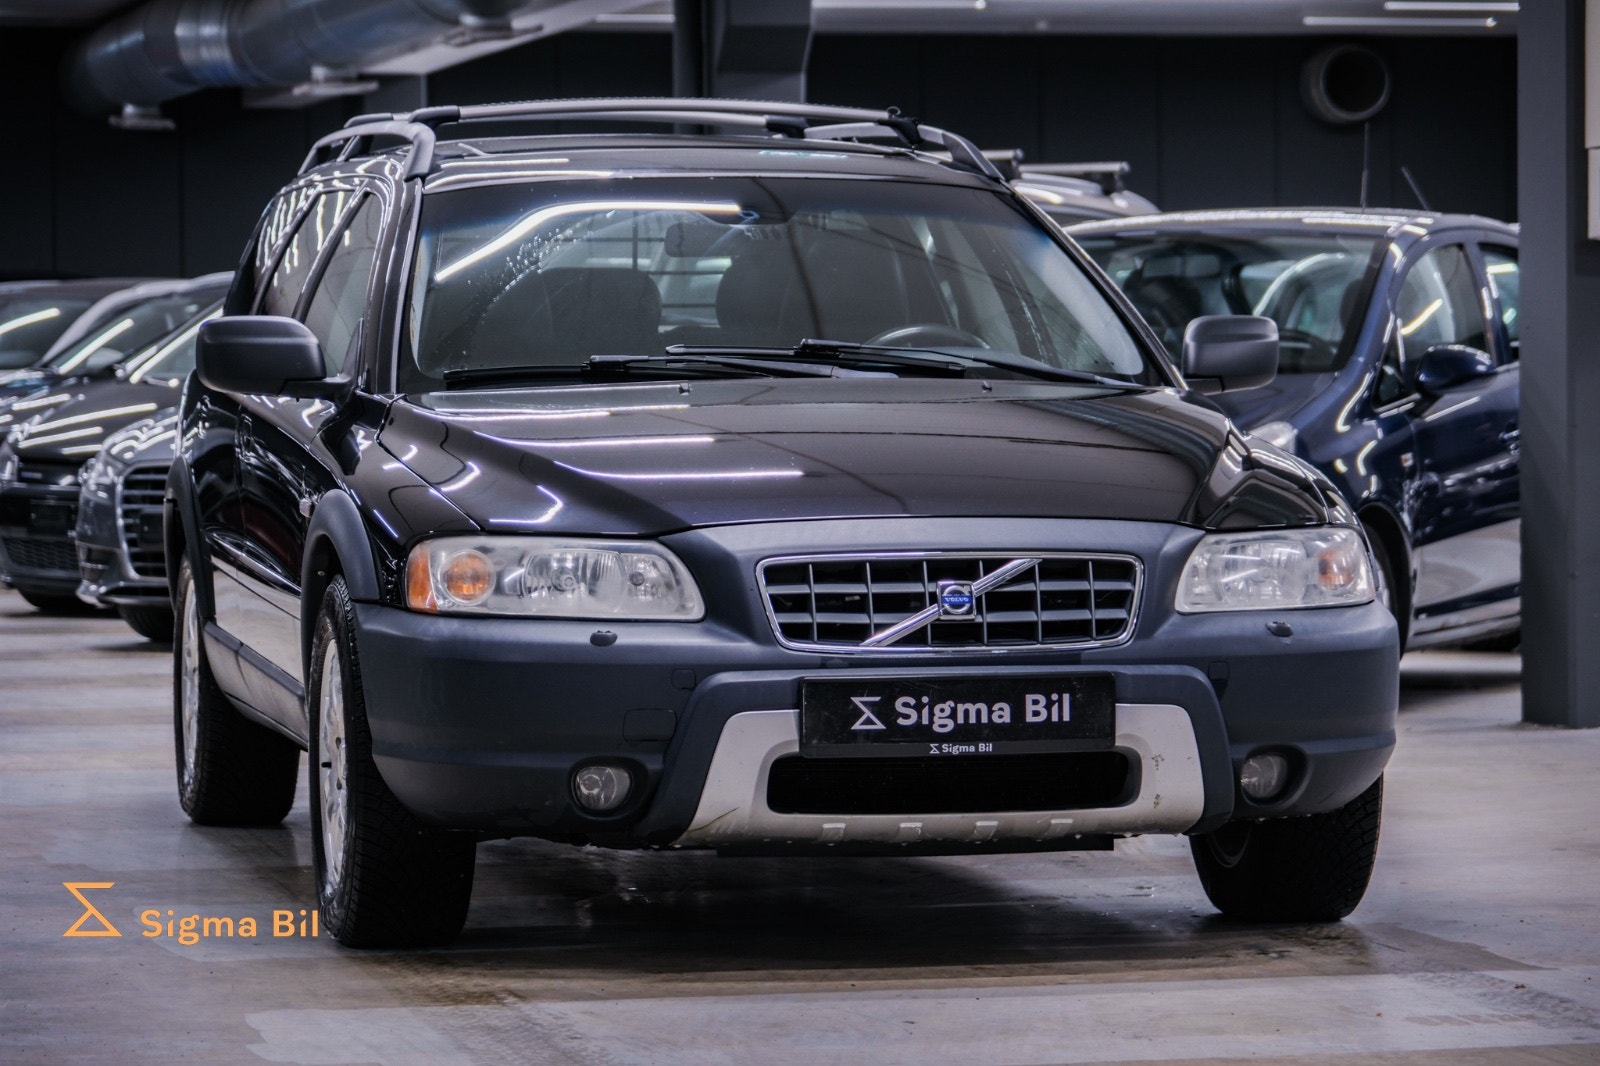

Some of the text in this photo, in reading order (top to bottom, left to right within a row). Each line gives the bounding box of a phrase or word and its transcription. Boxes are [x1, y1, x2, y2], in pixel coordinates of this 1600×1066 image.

[894, 693, 1070, 733] Sigma Bil
[942, 743, 992, 755] Sigma Bil
